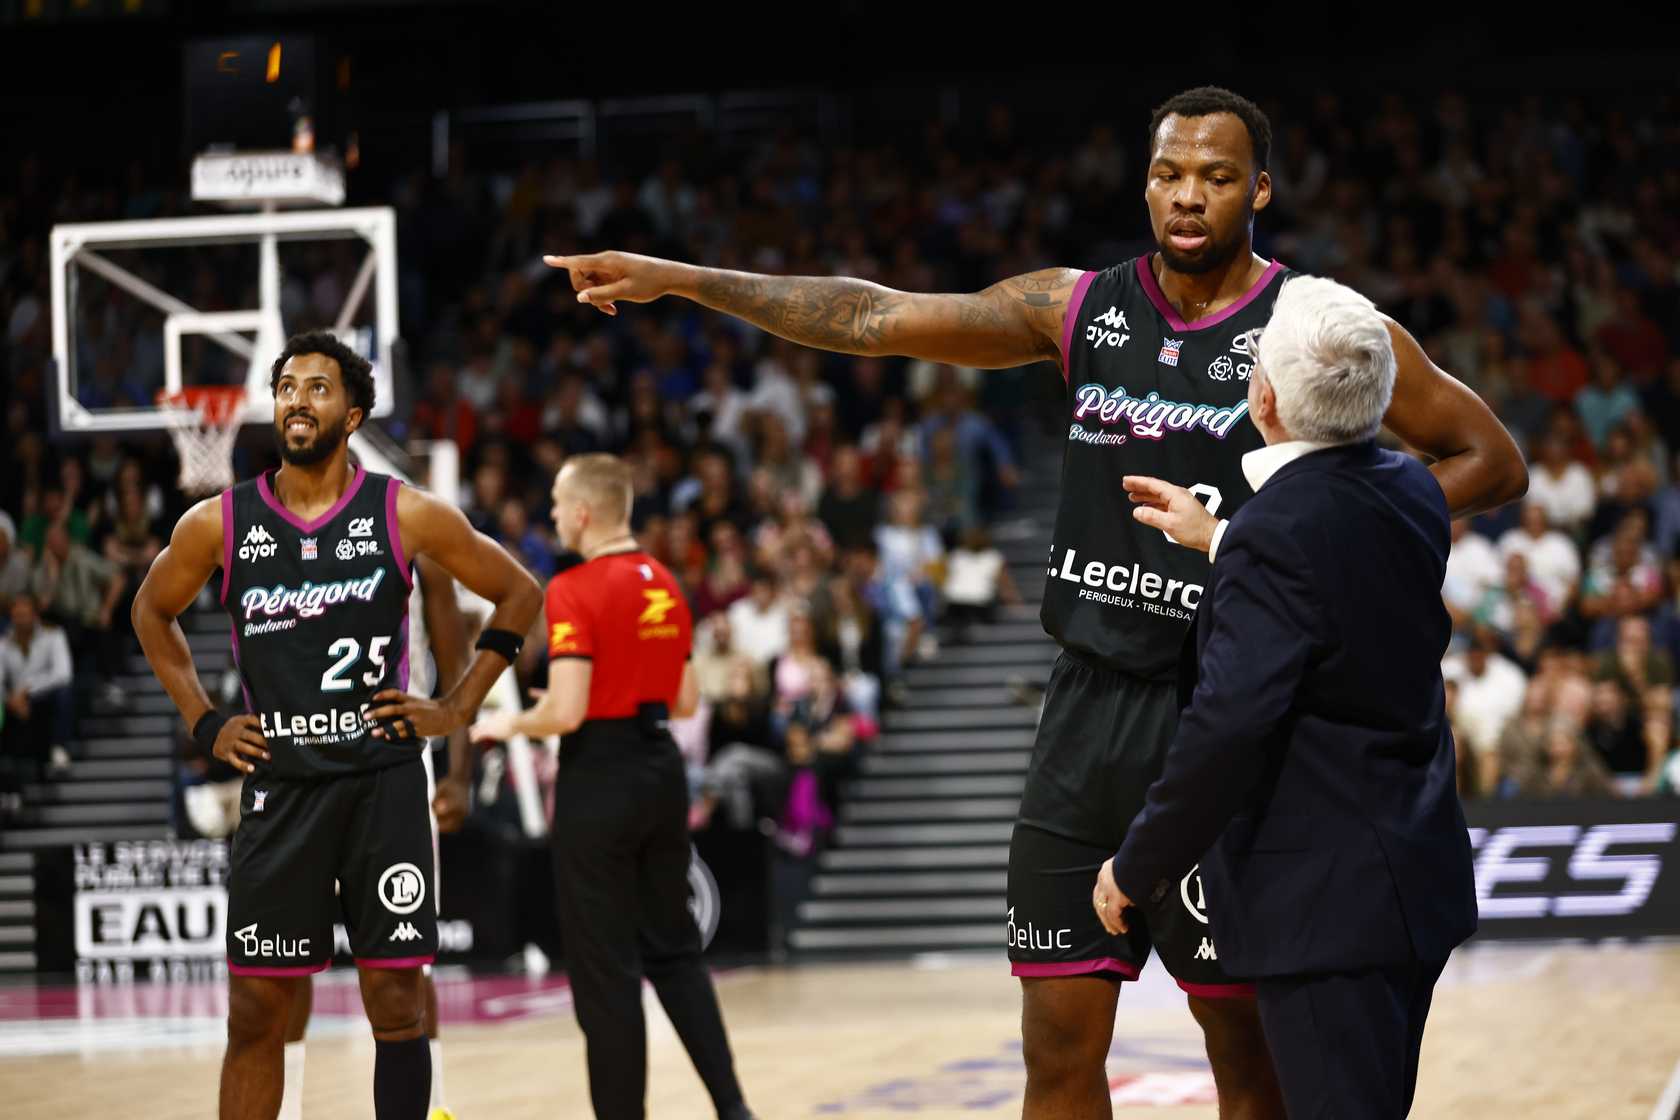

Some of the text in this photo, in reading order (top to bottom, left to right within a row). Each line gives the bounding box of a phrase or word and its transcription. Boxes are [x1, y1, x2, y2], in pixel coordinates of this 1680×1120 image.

[1086, 325, 1130, 349] ayor
[1074, 383, 1249, 440] Périgord
[1068, 423, 1127, 446] Boulazac
[238, 543, 278, 563] ayor
[241, 567, 386, 619] Périgord
[1047, 544, 1204, 610] .Leclerc
[1078, 589, 1134, 609] PERIGUEUX
[1142, 601, 1194, 621] TRELISSA
[320, 636, 396, 692] 25
[1465, 822, 1677, 919] ES
[90, 902, 217, 945] EAU
[240, 927, 311, 958] Deluc
[1008, 917, 1073, 950] Deluc
